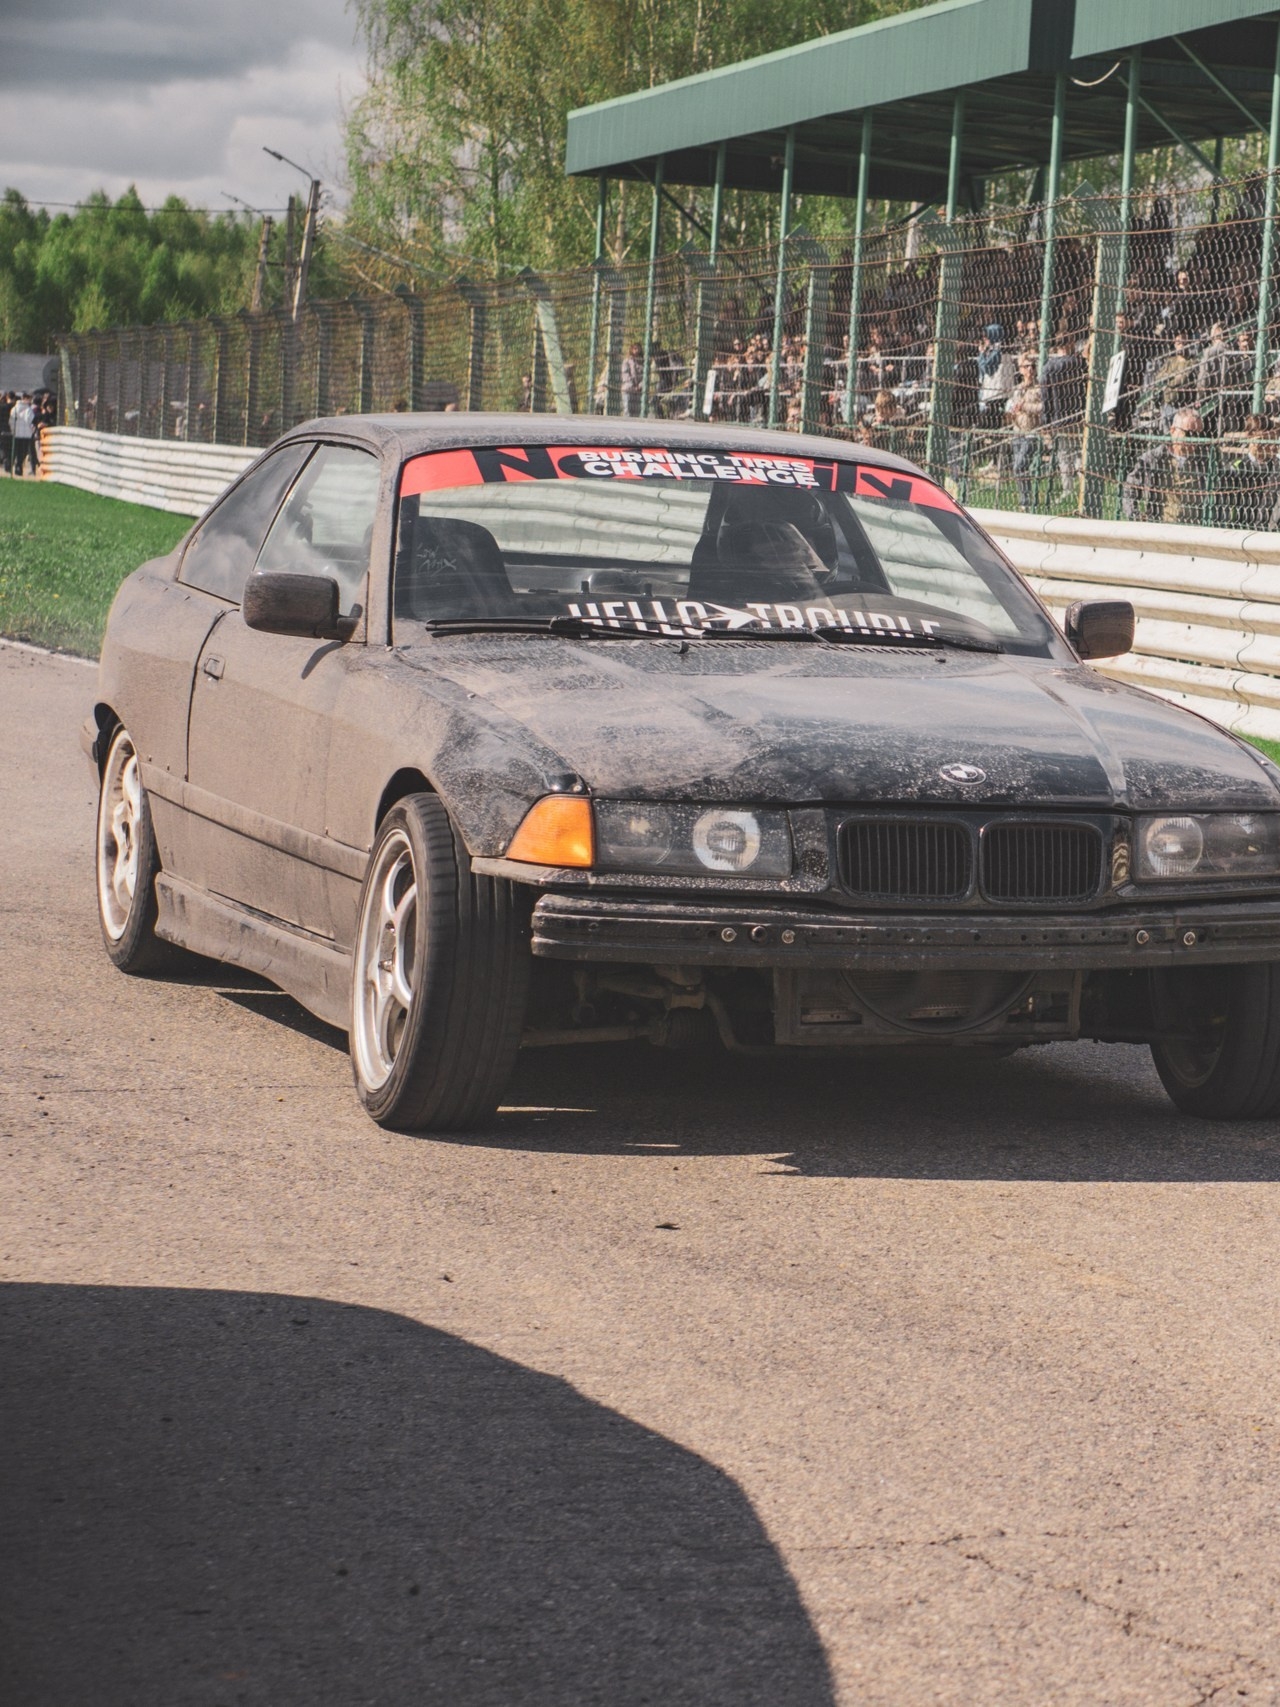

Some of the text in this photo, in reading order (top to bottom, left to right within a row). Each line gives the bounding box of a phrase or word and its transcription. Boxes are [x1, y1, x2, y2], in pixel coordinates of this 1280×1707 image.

[577, 451, 716, 467] BURNING
[723, 456, 811, 472] TIRES
[583, 461, 820, 486] CHALLENGE
[568, 601, 712, 636] HELLO
